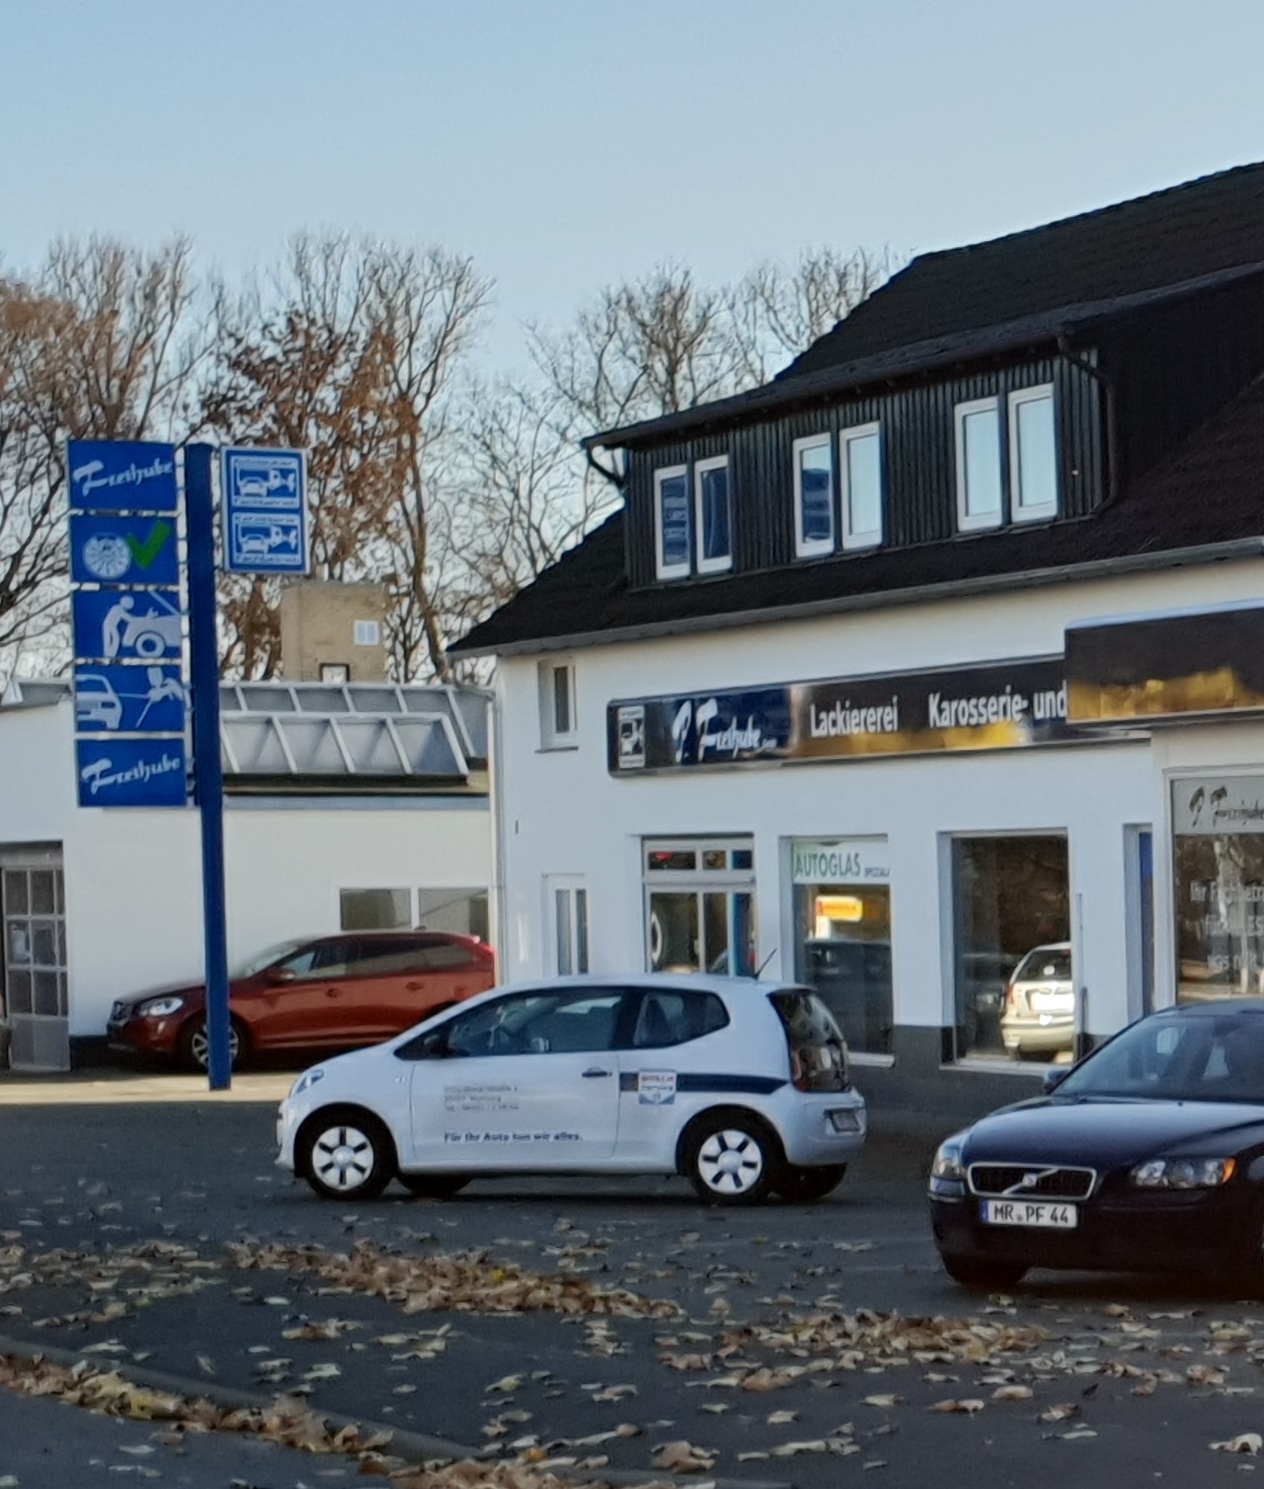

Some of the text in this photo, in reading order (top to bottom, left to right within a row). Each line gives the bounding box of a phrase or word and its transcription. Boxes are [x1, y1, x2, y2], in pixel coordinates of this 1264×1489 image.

[810, 680, 1068, 737] Lackiererei Karosserie- und
[795, 852, 861, 877] AUTOGLAS
[994, 1203, 1069, 1224] MR PF 44
